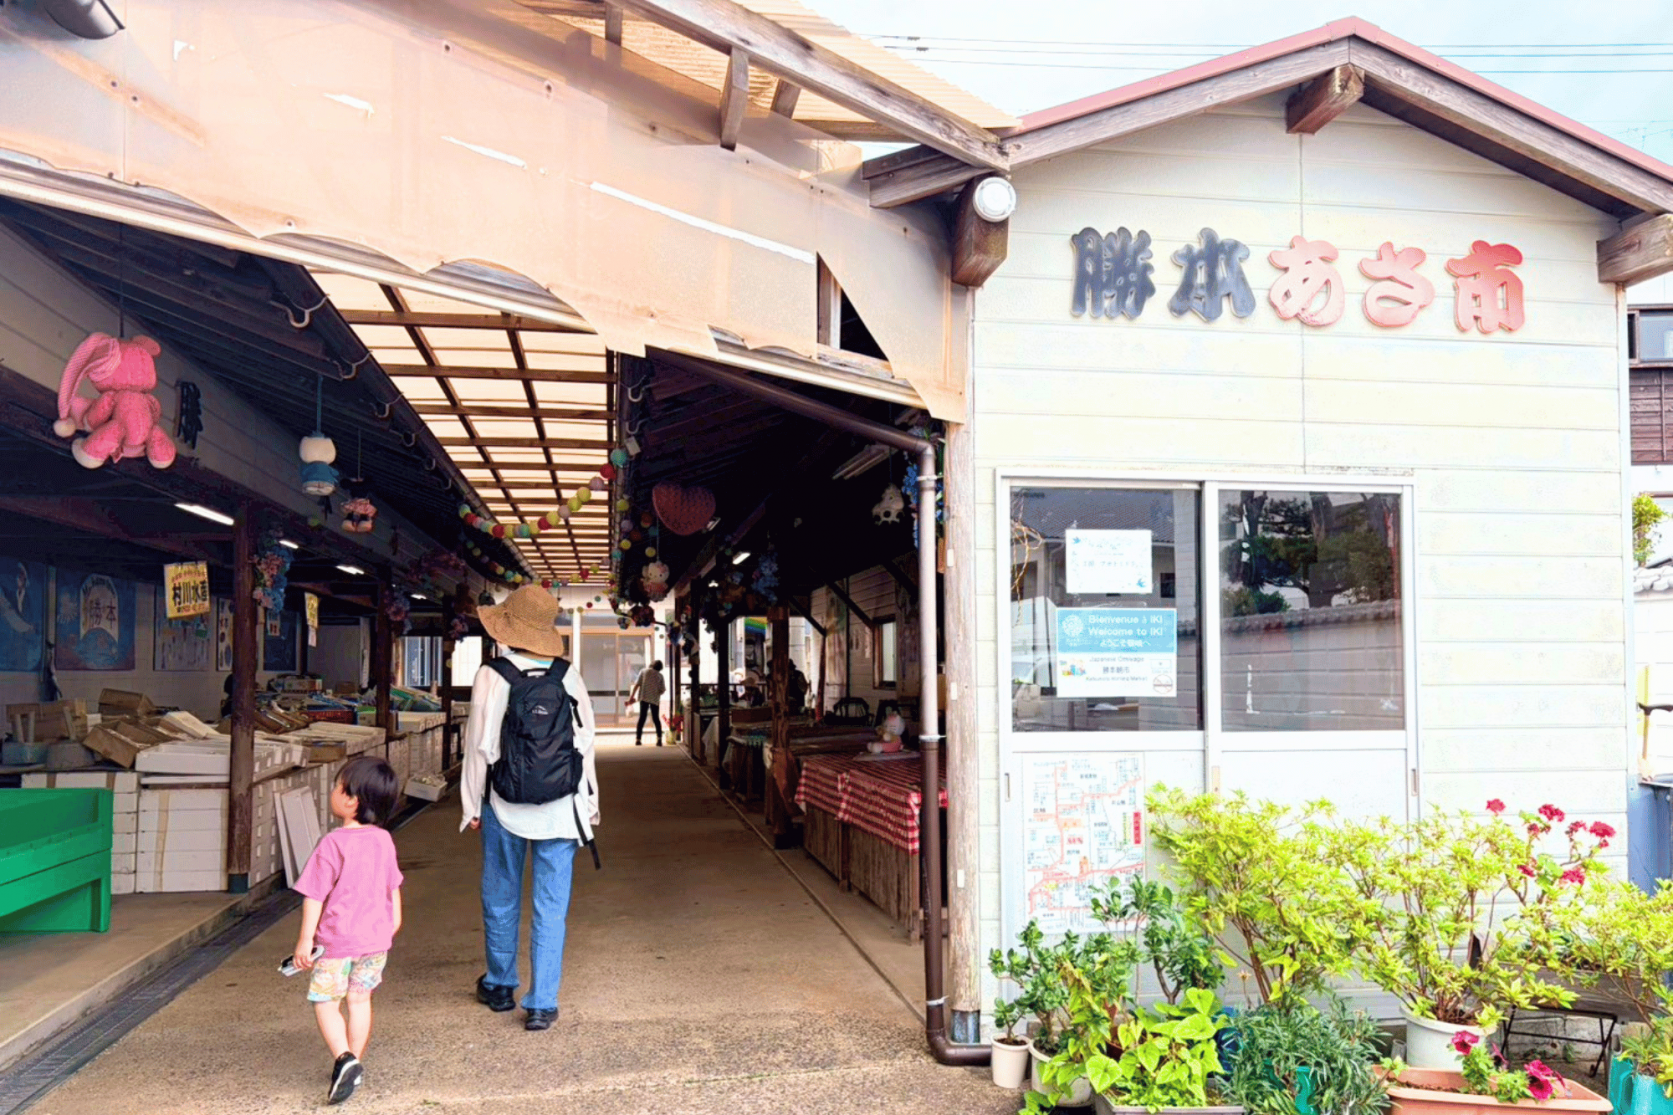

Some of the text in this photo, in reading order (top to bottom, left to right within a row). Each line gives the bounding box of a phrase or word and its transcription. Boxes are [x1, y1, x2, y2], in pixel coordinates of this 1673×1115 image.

[1070, 226, 1526, 334] 勝本あさ市
[172, 579, 208, 607] 村川水産
[1088, 614, 1139, 624] Bienvenue
[1150, 614, 1163, 624] IKI
[1088, 627, 1163, 636] Welcome to IKI
